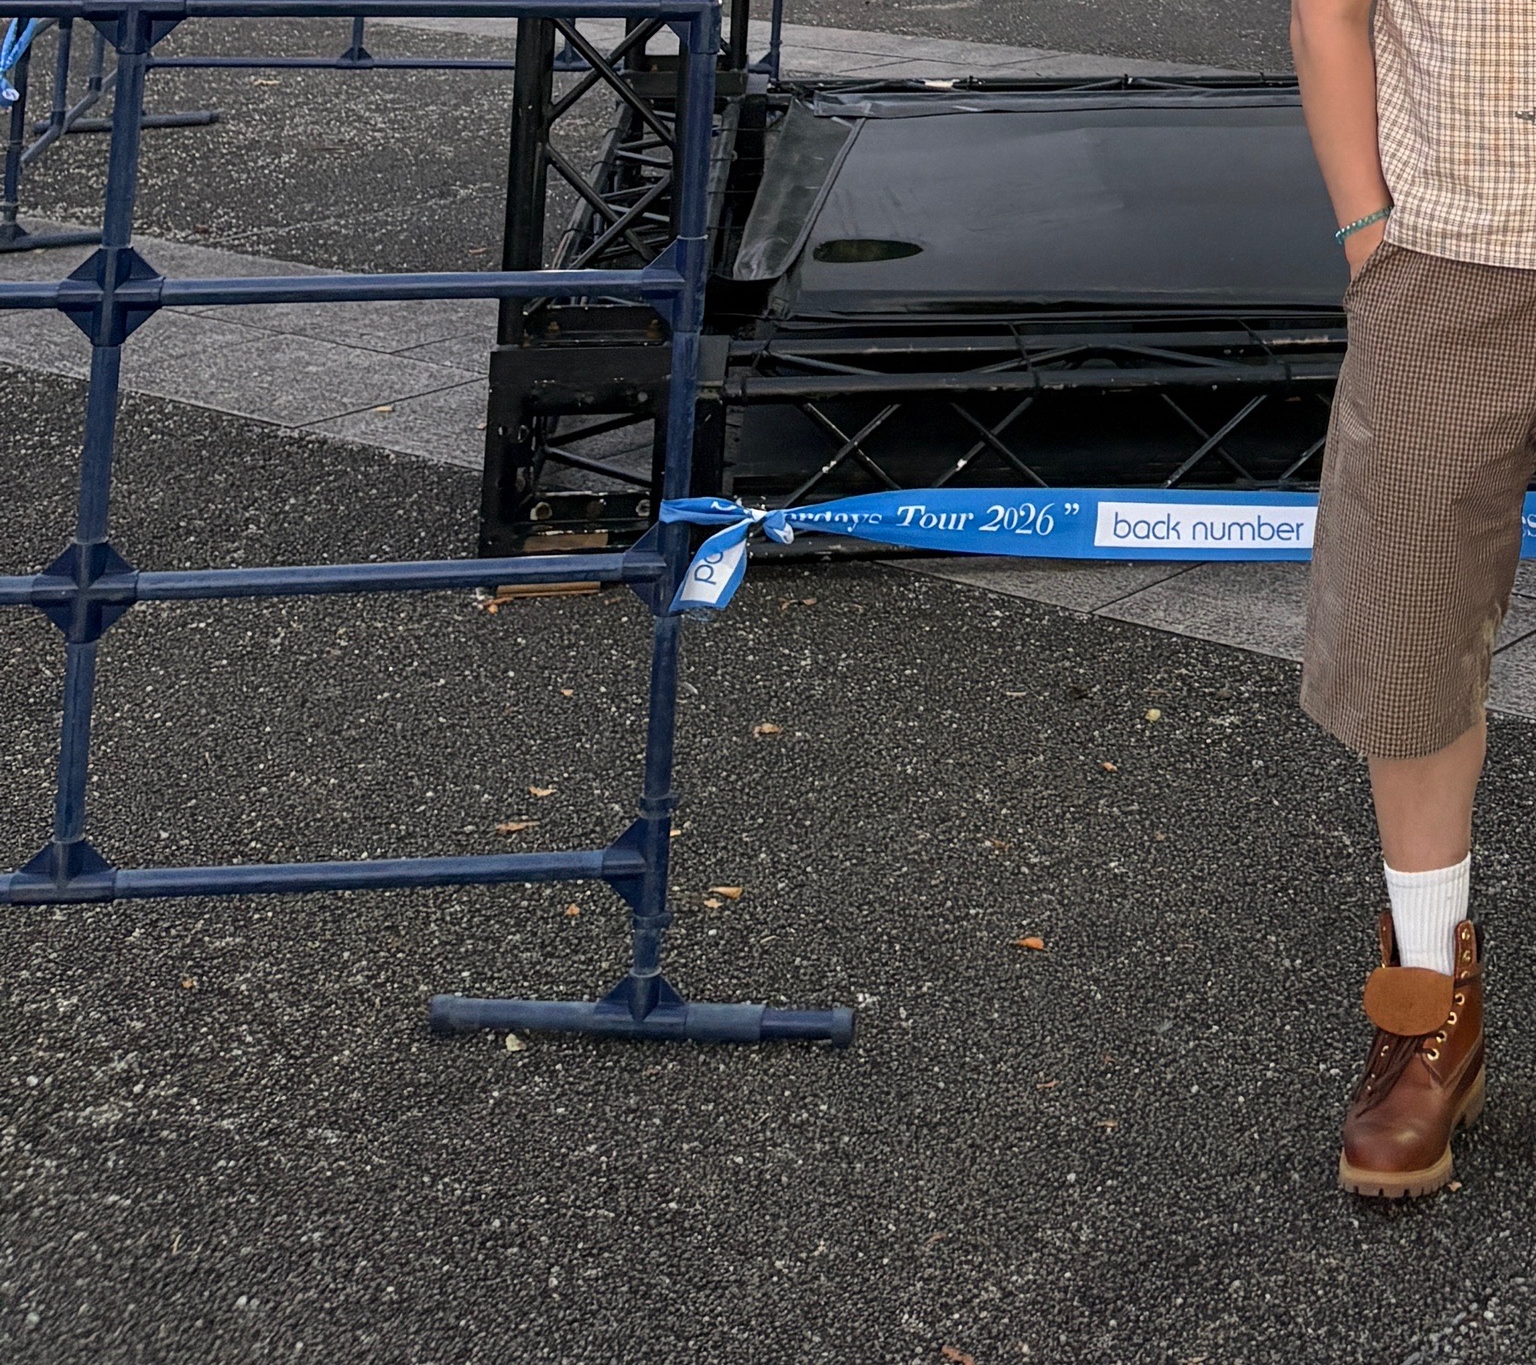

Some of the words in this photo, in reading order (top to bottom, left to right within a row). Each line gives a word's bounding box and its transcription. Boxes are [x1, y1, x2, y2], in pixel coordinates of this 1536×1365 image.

[895, 505, 974, 531] Tour
[979, 502, 1055, 536] 2026
[1113, 511, 1181, 541] back
[1192, 514, 1305, 541] number
